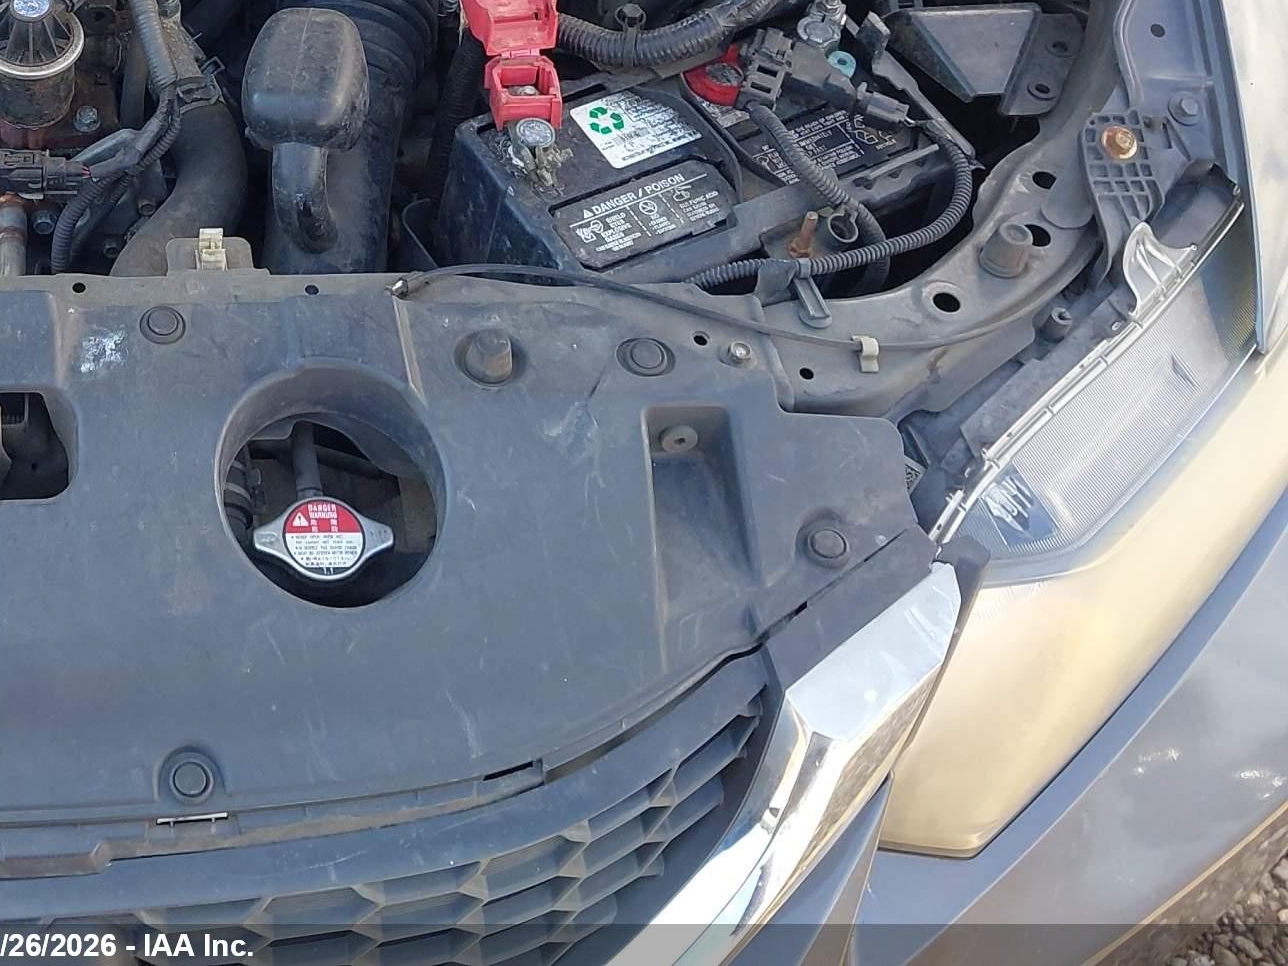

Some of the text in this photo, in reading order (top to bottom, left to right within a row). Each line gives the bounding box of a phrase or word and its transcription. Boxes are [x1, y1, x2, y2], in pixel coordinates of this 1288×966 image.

[591, 192, 638, 215] DANGER
[644, 173, 685, 194] POISON
[307, 503, 337, 512] DANGER
